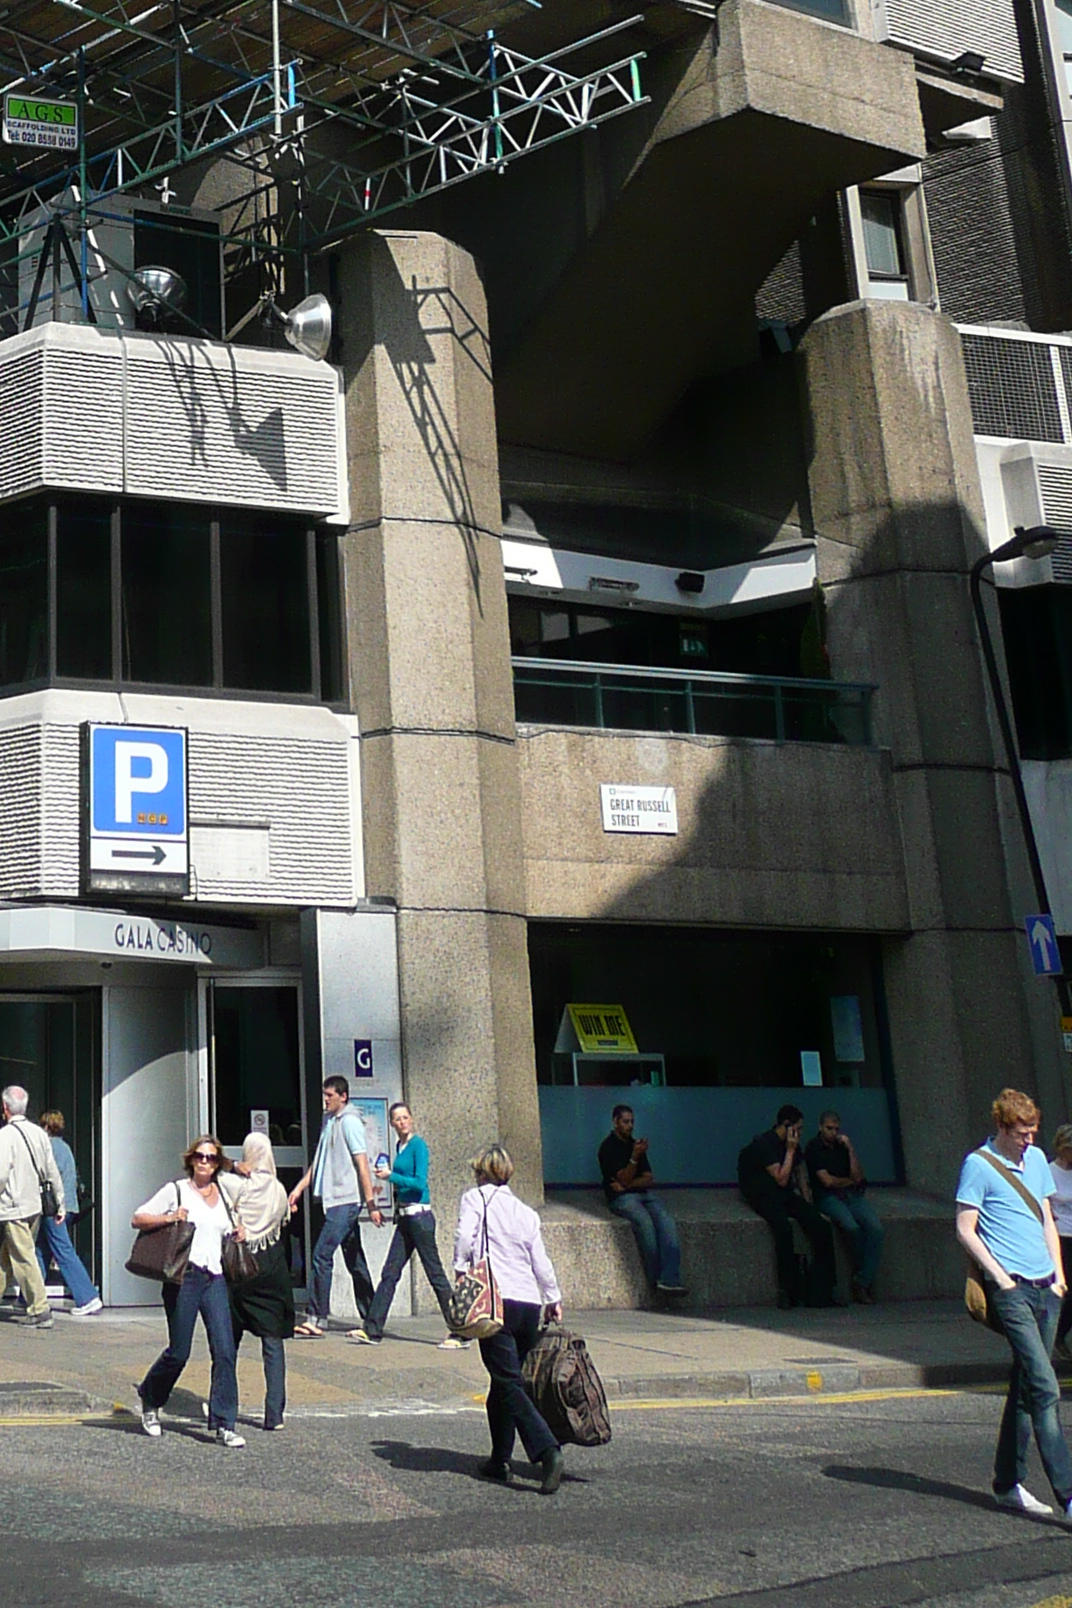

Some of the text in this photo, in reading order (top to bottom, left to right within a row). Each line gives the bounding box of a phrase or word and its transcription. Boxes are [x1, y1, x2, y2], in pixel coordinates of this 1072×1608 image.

[17, 101, 63, 122] AGS
[8, 120, 76, 136] SCAFFOLDING LTD
[22, 131, 36, 143] 020
[115, 740, 169, 824] P
[610, 798, 671, 813] GREAT RUSSELL
[137, 812, 168, 825] NCP
[611, 814, 640, 827] STREET
[115, 923, 212, 954] GALA CASINO
[578, 1015, 626, 1036] WIN ME
[356, 1048, 371, 1069] G
